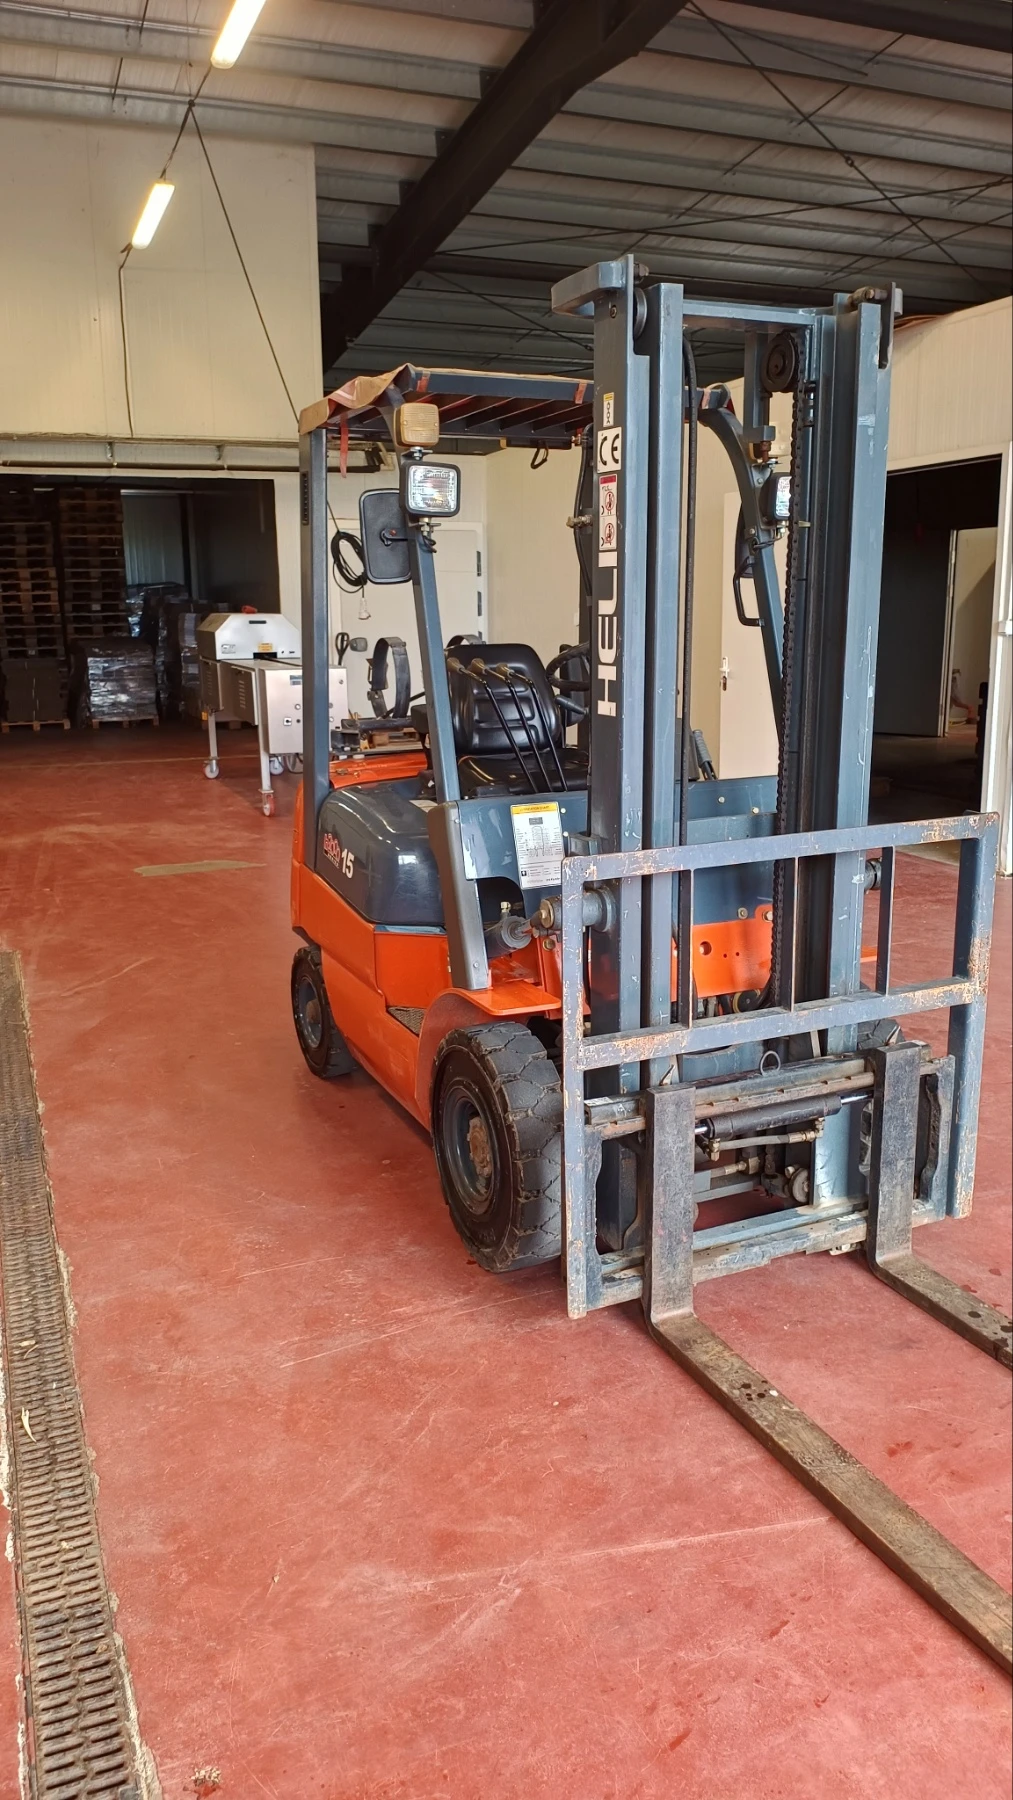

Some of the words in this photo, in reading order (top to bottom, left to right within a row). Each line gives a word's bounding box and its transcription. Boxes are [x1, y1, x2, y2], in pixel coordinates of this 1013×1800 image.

[599, 433, 620, 467] CE
[598, 551, 618, 717] HELI
[341, 848, 355, 879] 15
